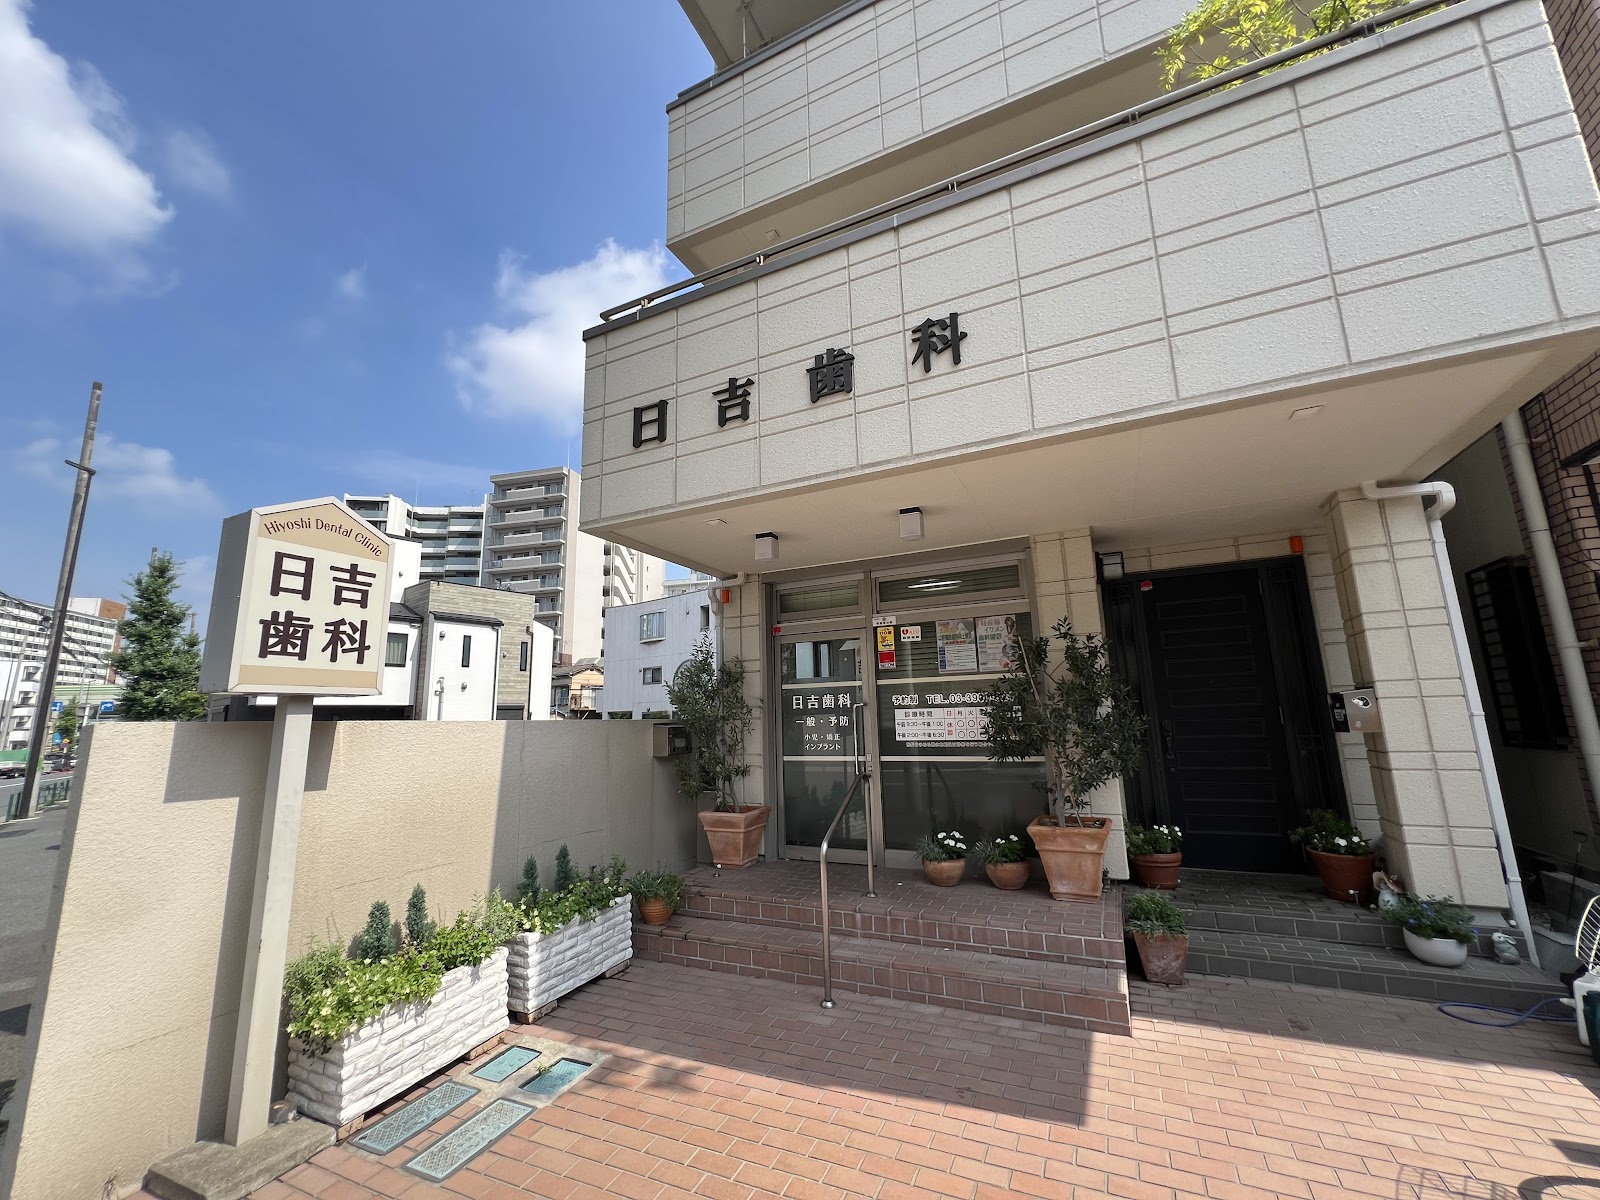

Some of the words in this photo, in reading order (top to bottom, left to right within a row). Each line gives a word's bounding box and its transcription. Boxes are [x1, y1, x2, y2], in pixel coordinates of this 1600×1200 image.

[633, 312, 968, 448] 日吉歯科
[264, 517, 311, 535] Hiyoshi
[315, 518, 353, 538] Dental
[354, 532, 383, 557] Clinic
[270, 551, 377, 609] 日吉
[258, 610, 371, 665] 歯科
[792, 692, 852, 710] 日吉歯科
[796, 715, 850, 727] 一般・予防
[804, 743, 841, 751] インプラント
